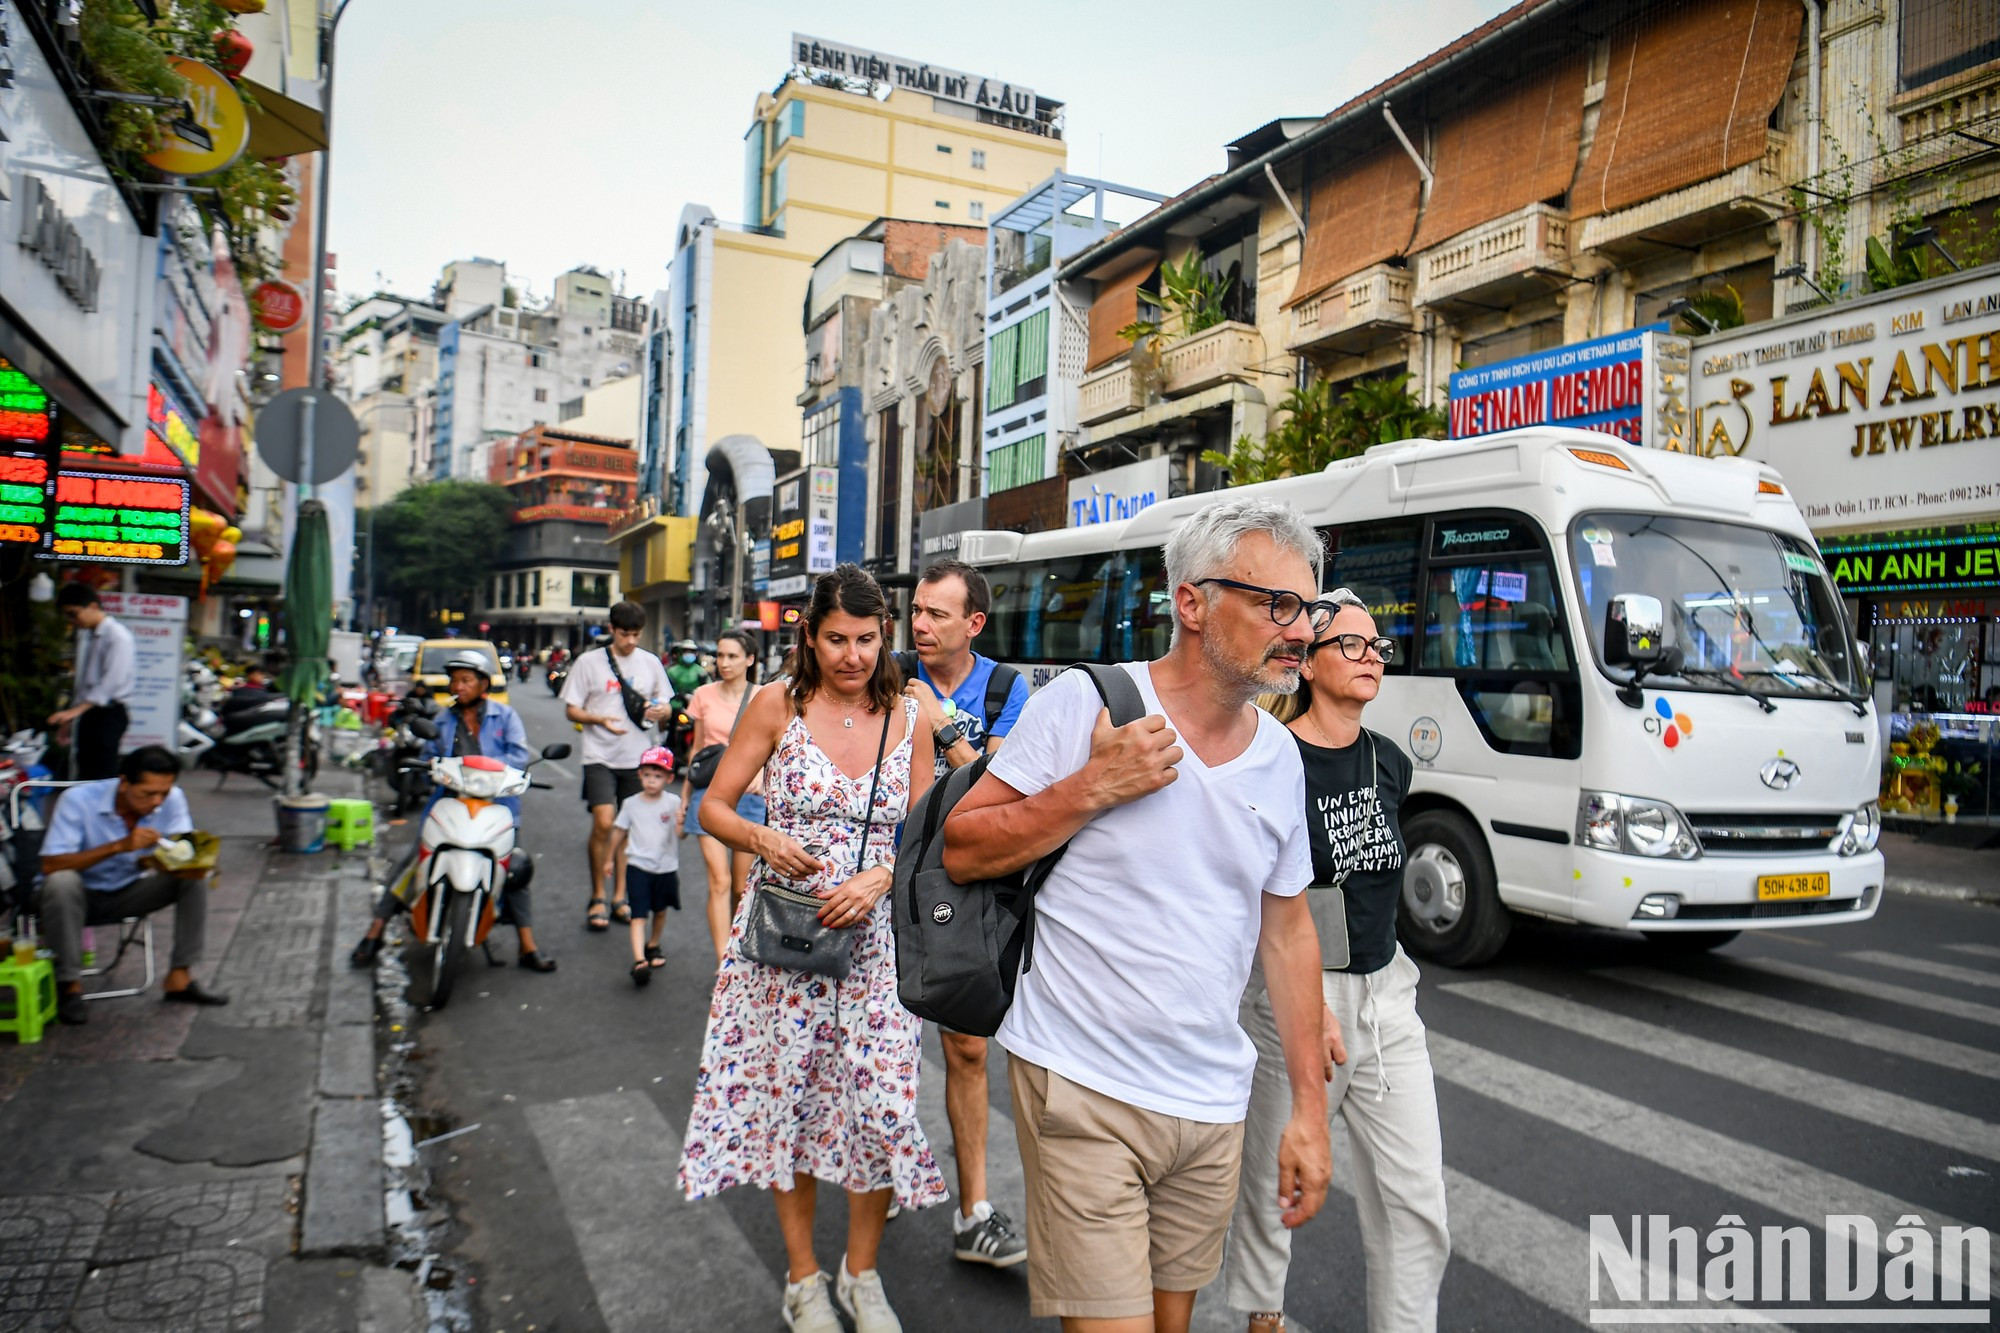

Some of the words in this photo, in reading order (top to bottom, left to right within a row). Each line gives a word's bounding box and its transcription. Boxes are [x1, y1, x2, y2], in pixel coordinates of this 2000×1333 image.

[852, 53, 890, 81] VIỆN
[1702, 353, 1733, 376] CÔNG
[1736, 352, 1751, 368] TY
[1754, 343, 1787, 365] TNHH
[1789, 338, 1806, 356] TM
[1830, 323, 1877, 347] TRANG
[1891, 310, 1925, 335] KIM
[1943, 300, 1972, 322] LAN
[1479, 371, 1490, 384] TY
[1544, 357, 1556, 370] DU
[1577, 341, 1616, 362] VIETNAM
[1451, 379, 1547, 438] VIETNAM
[1553, 359, 1643, 420] MEMOR
[1769, 357, 1874, 426] LAN
[1806, 503, 1831, 518] Thành
[1834, 500, 1857, 517] Quận
[1885, 494, 1908, 509] HCM
[1916, 491, 1947, 505] Phone:
[1949, 486, 1973, 502] 0902
[1975, 483, 1992, 499] 284
[1441, 529, 1510, 549] TRACOMECO
[1833, 556, 1873, 583] AN
[1880, 551, 1946, 582] ANH
[1884, 600, 1930, 618] LAN
[1937, 599, 1986, 618] ANH
[1644, 717, 1661, 737] CJ
[1317, 793, 1343, 812] UN
